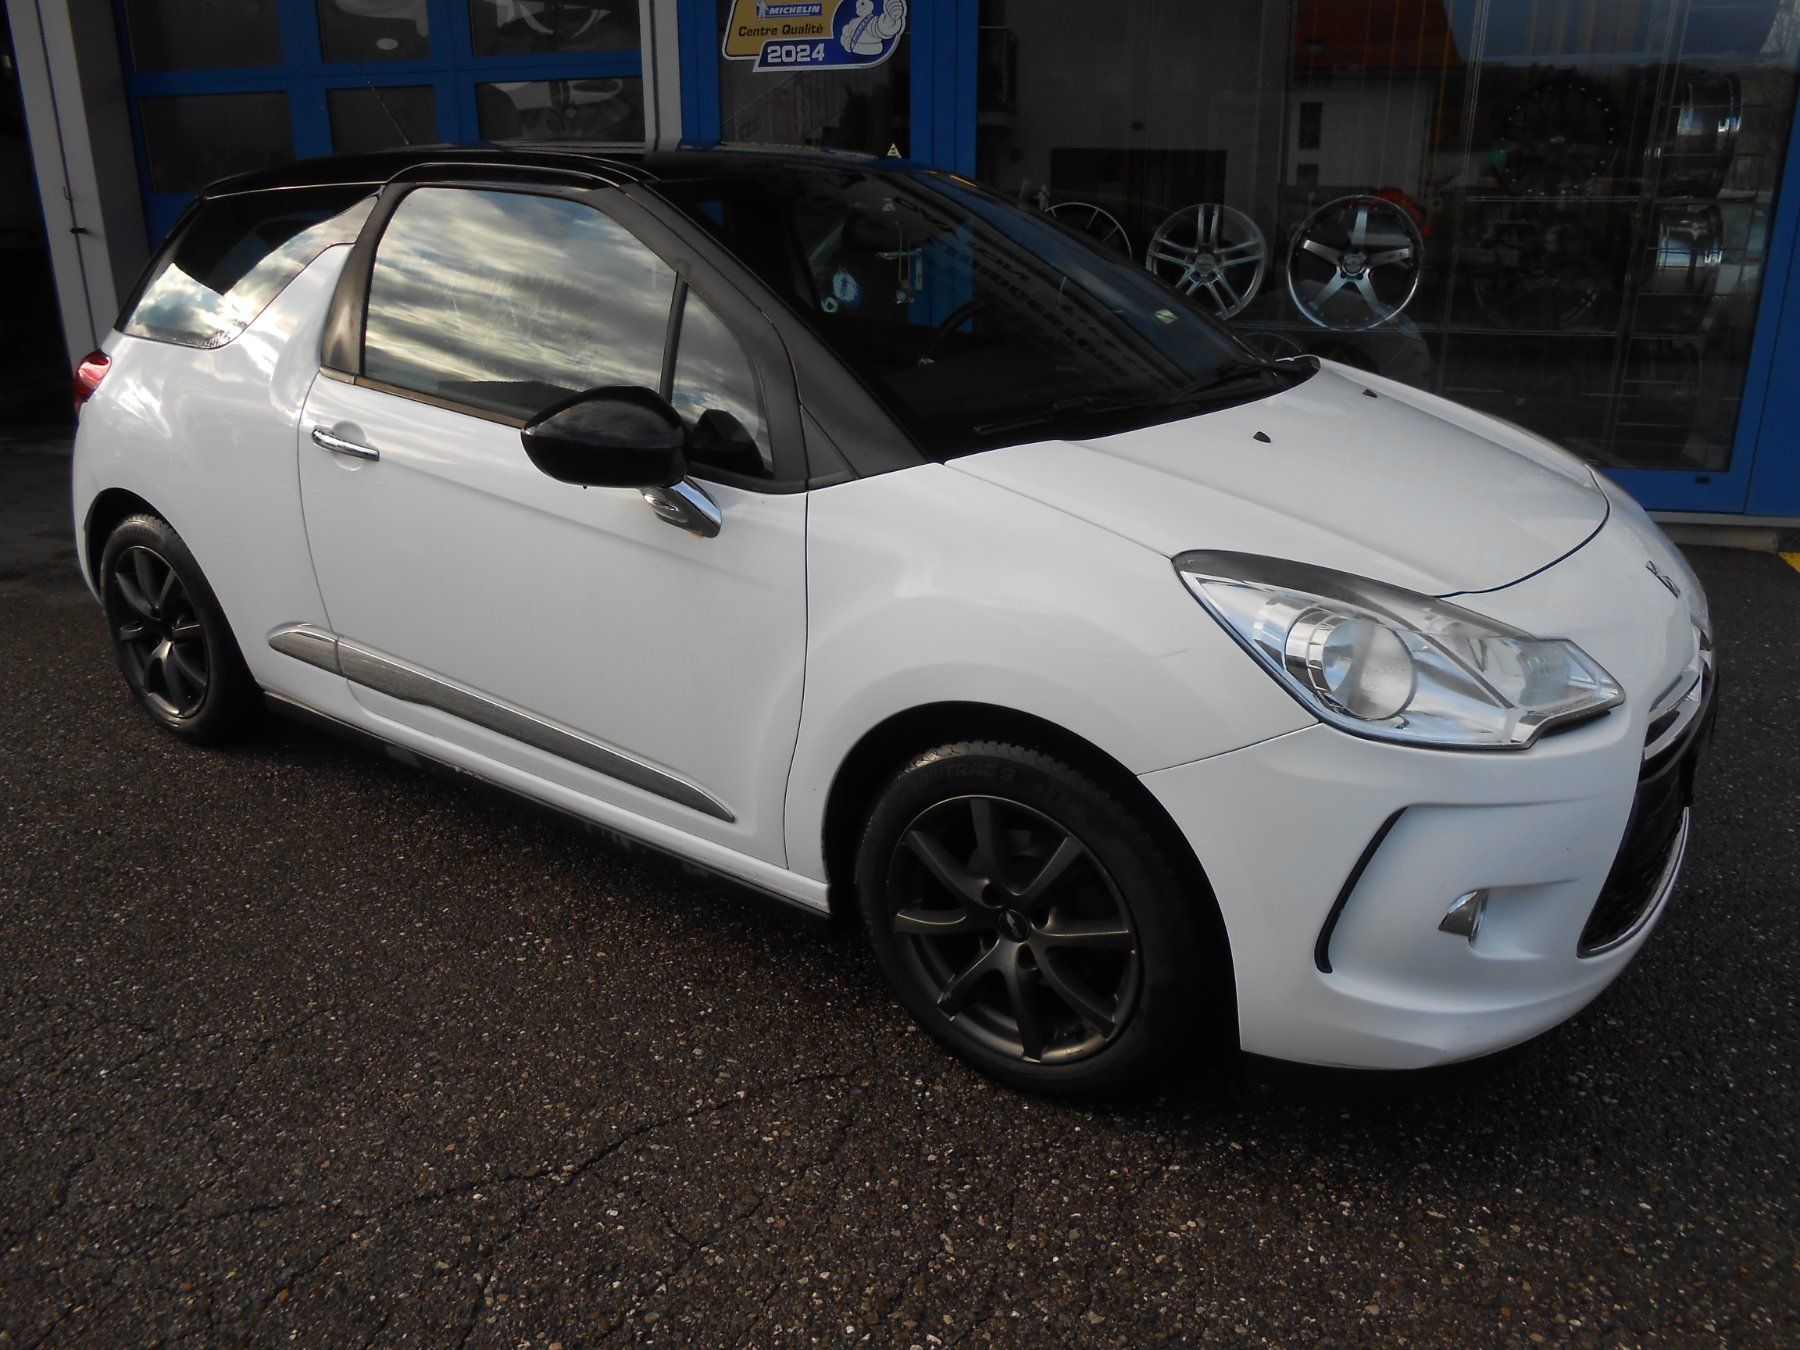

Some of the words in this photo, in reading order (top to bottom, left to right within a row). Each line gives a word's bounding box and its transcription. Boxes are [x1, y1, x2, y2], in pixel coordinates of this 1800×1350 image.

[769, 5, 820, 15] MICHELIN
[738, 26, 778, 37] Centre
[782, 23, 823, 36] Qualité
[767, 43, 825, 63] 2024
